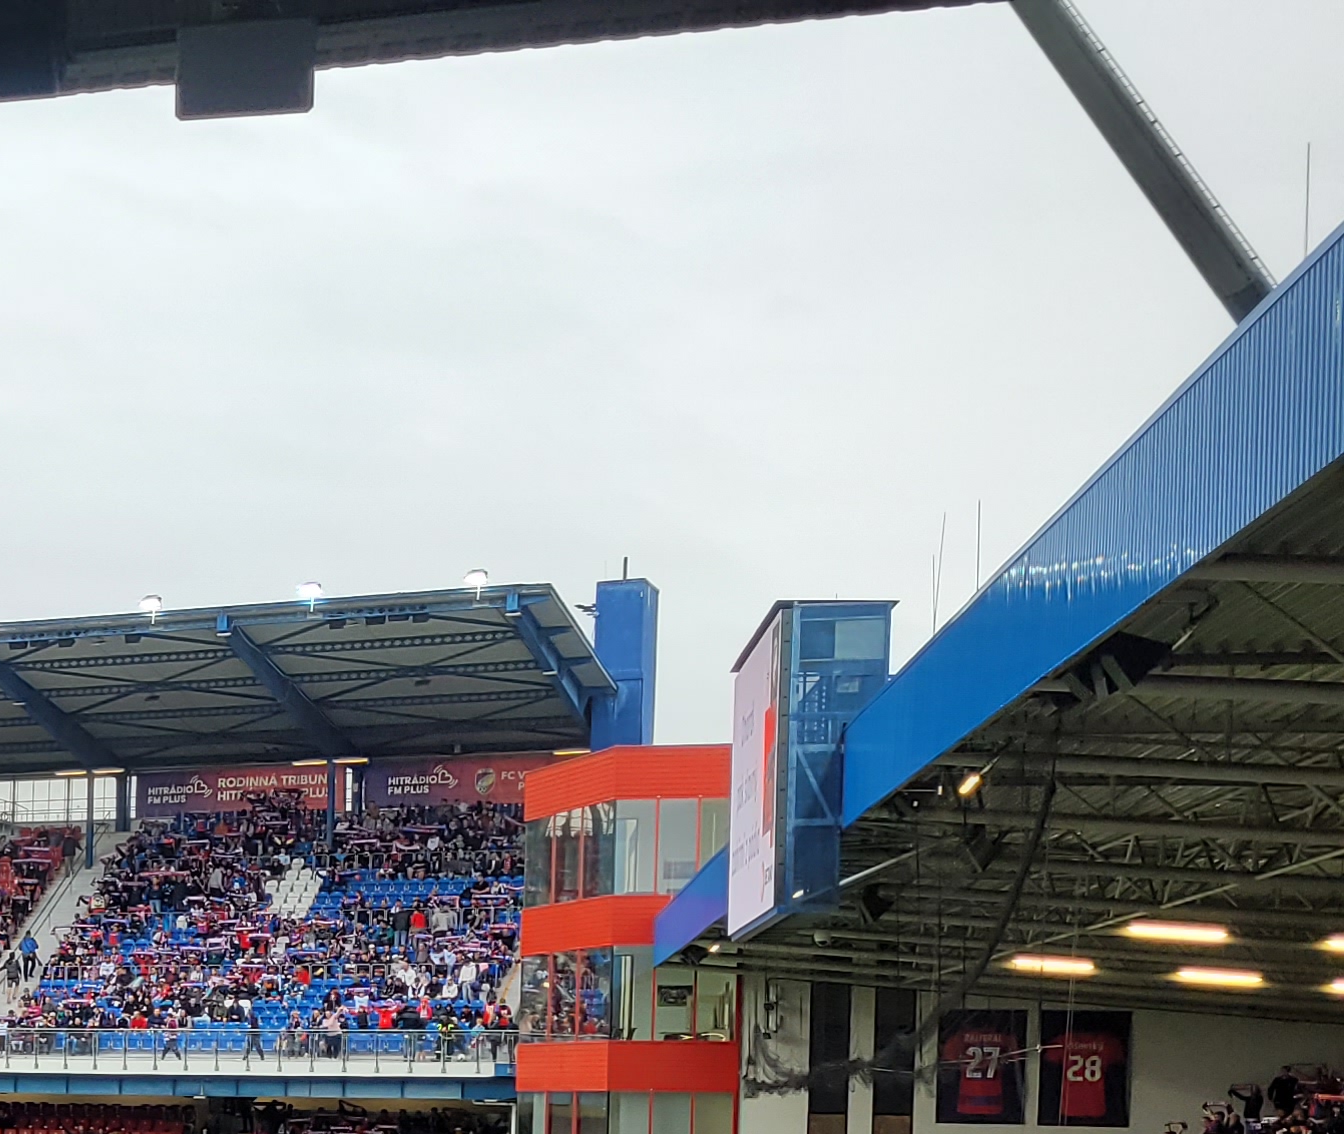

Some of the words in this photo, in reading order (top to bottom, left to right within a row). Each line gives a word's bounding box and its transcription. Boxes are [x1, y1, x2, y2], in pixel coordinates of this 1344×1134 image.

[217, 773, 277, 789] RODINNÁ
[280, 772, 336, 786] TRIBUN
[388, 774, 437, 787] HITRÁDIO
[500, 771, 515, 780] FC
[147, 784, 194, 796] HITRÁDIO
[387, 786, 402, 796] FM
[403, 784, 430, 795] PLUS
[147, 795, 161, 804] FM
[162, 794, 187, 805] PLUS
[965, 1046, 1000, 1079] 27
[1066, 1055, 1102, 1082] 28
